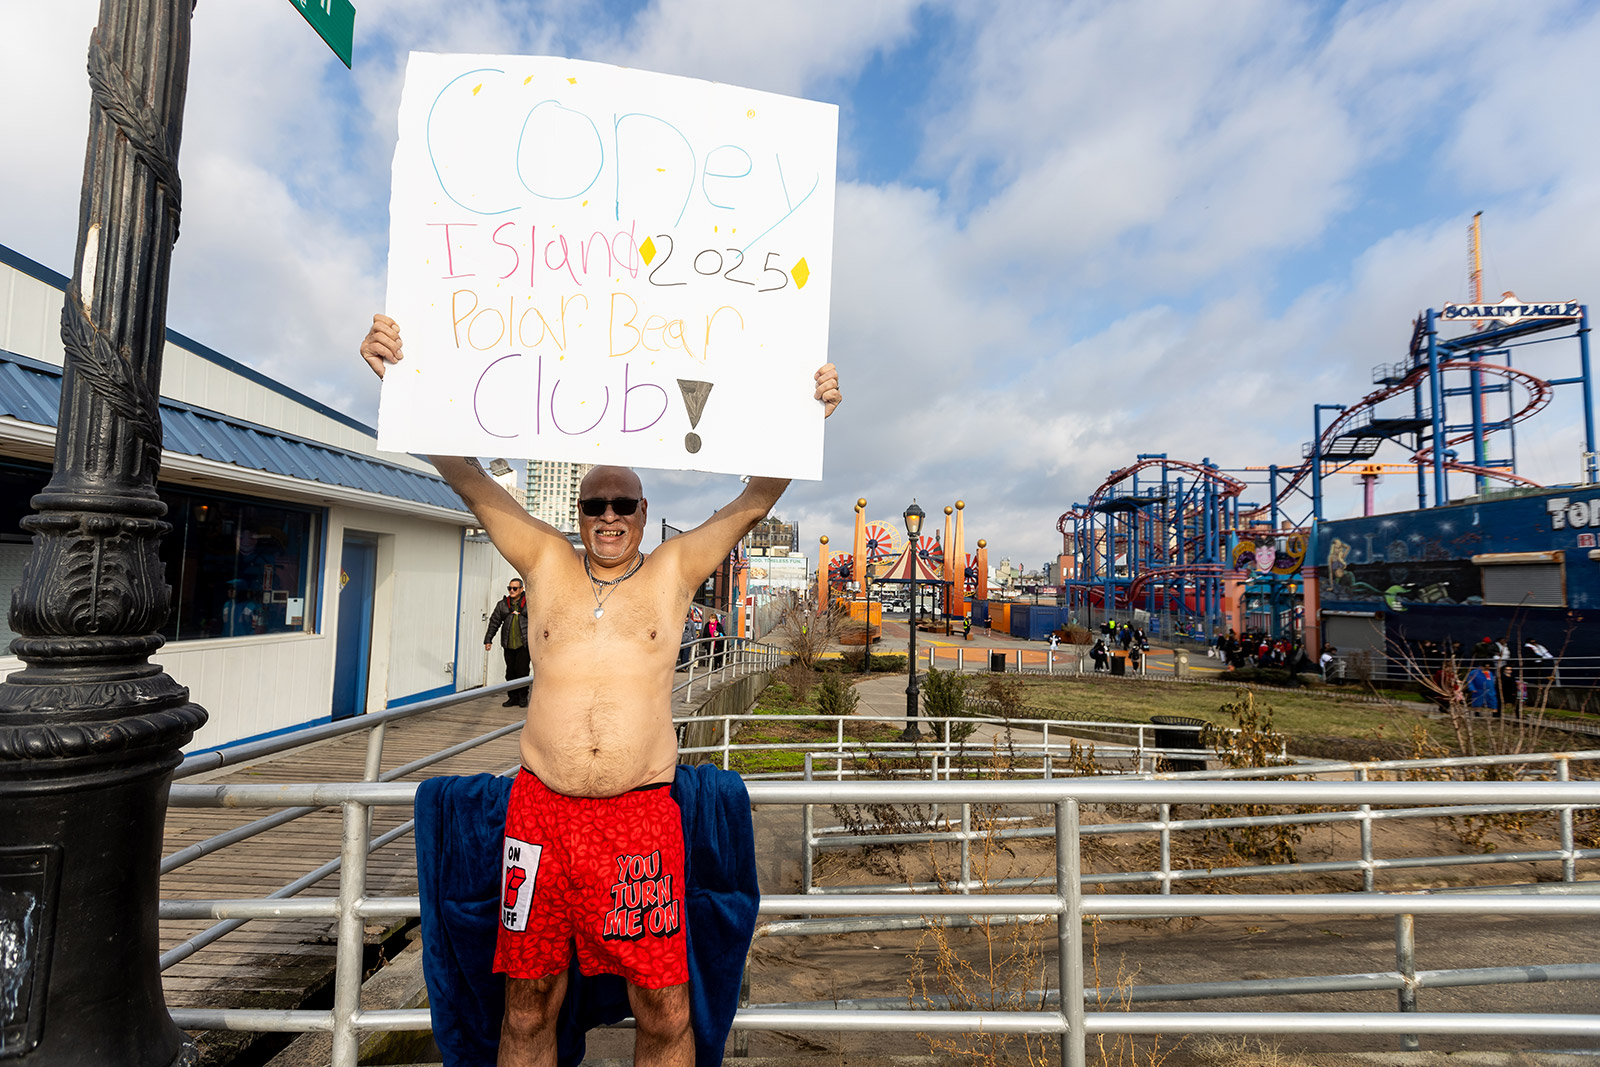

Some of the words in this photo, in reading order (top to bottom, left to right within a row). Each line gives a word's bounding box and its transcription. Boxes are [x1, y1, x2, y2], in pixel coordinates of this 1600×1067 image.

[427, 69, 819, 258] Coney
[648, 234, 788, 292] 2025
[452, 290, 588, 351] Polar
[609, 293, 744, 364] Bear
[1521, 303, 1580, 317] EAGLE
[508, 846, 521, 861] ON
[617, 850, 661, 882] YOU
[610, 874, 672, 910] TURN
[602, 908, 646, 942] ME
[647, 899, 681, 939] ON
